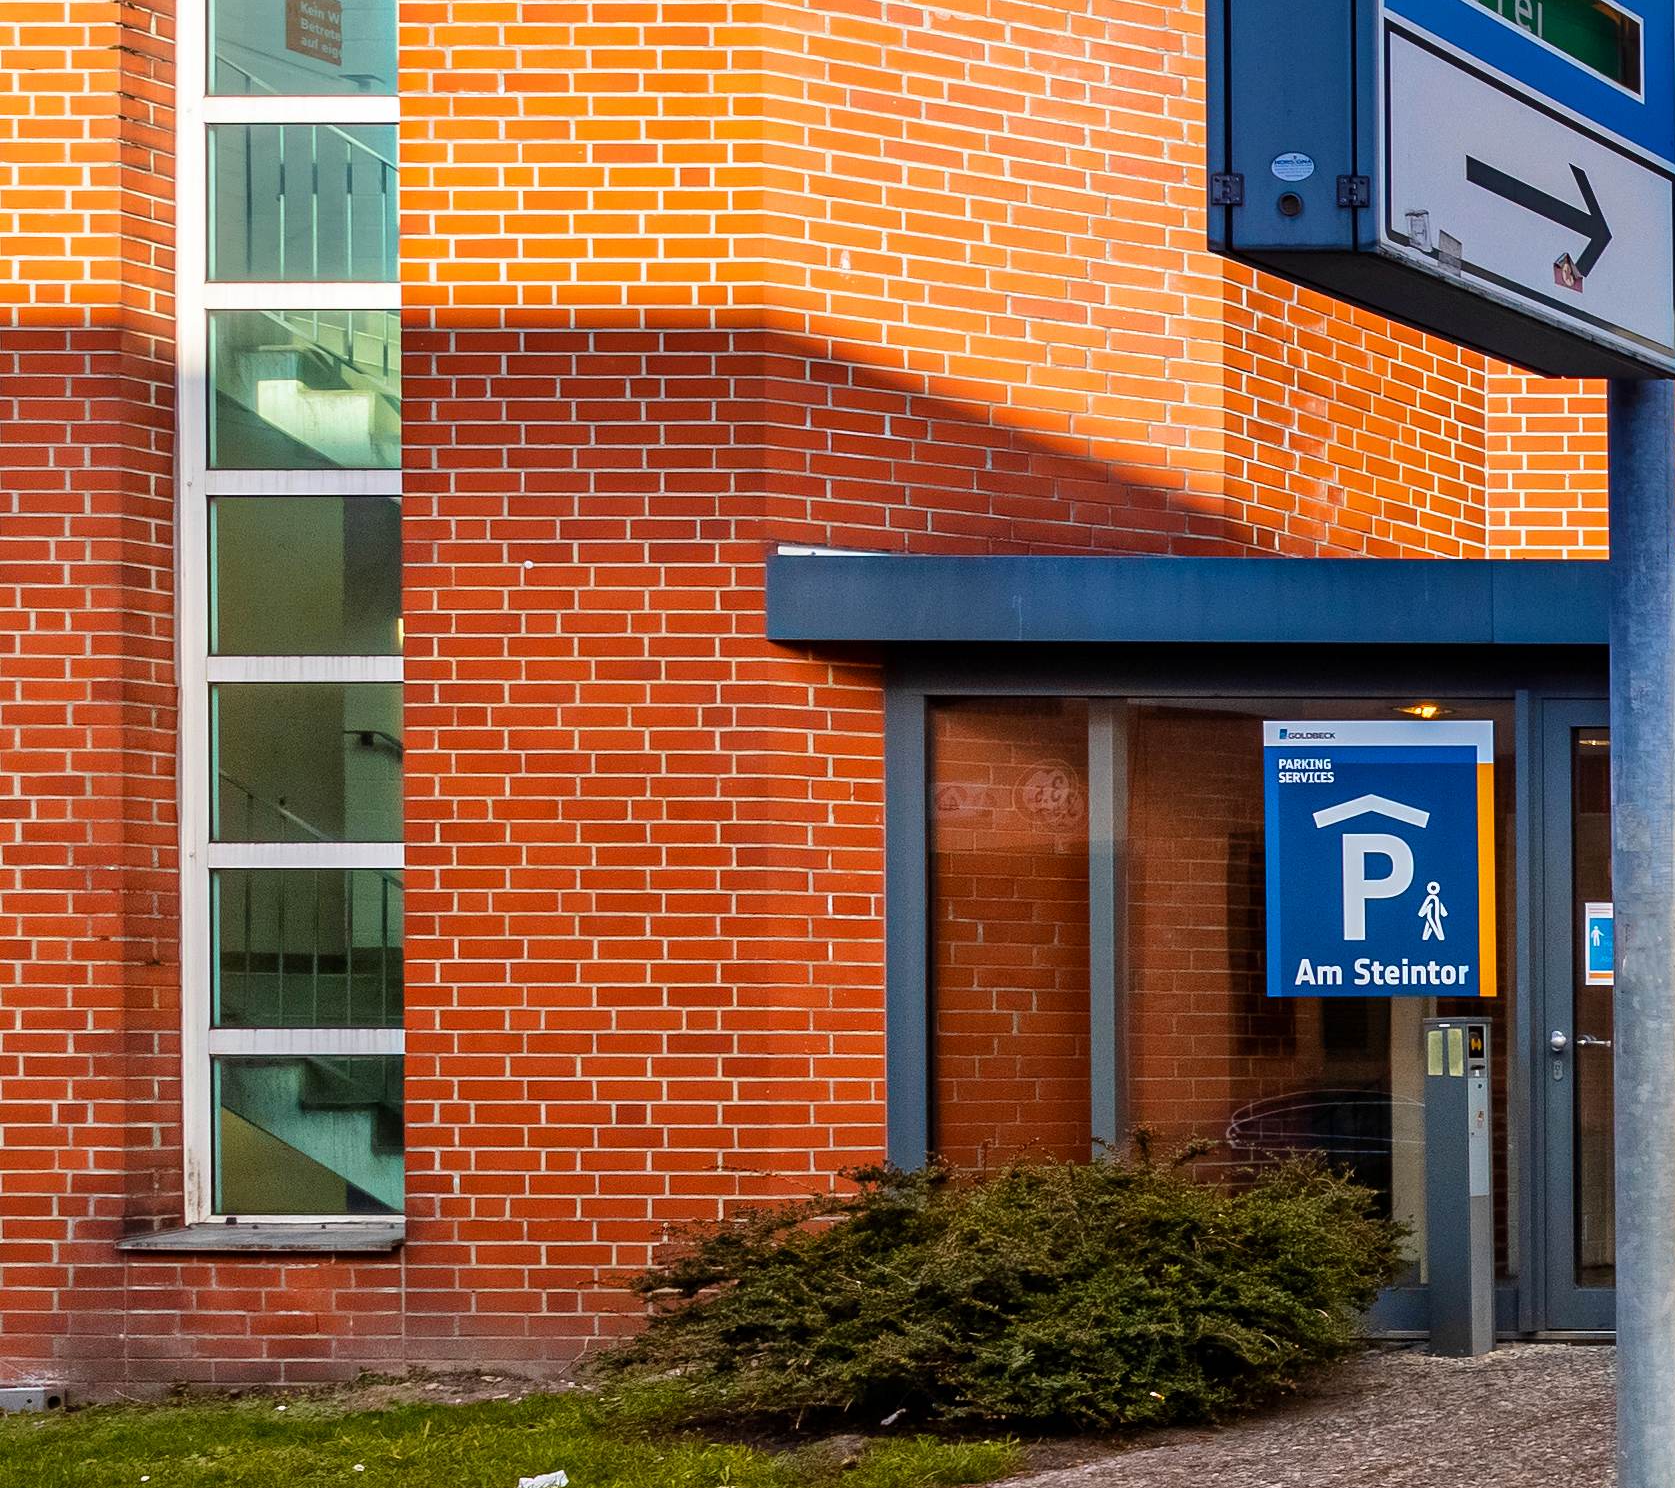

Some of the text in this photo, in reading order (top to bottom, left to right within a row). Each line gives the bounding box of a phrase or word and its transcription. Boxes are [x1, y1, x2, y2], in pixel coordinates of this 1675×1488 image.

[1288, 731, 1336, 740] GOLDBECK
[1278, 758, 1332, 770] PARKING
[1278, 771, 1335, 783] SERVICES
[1295, 958, 1470, 986] Am Steintor
